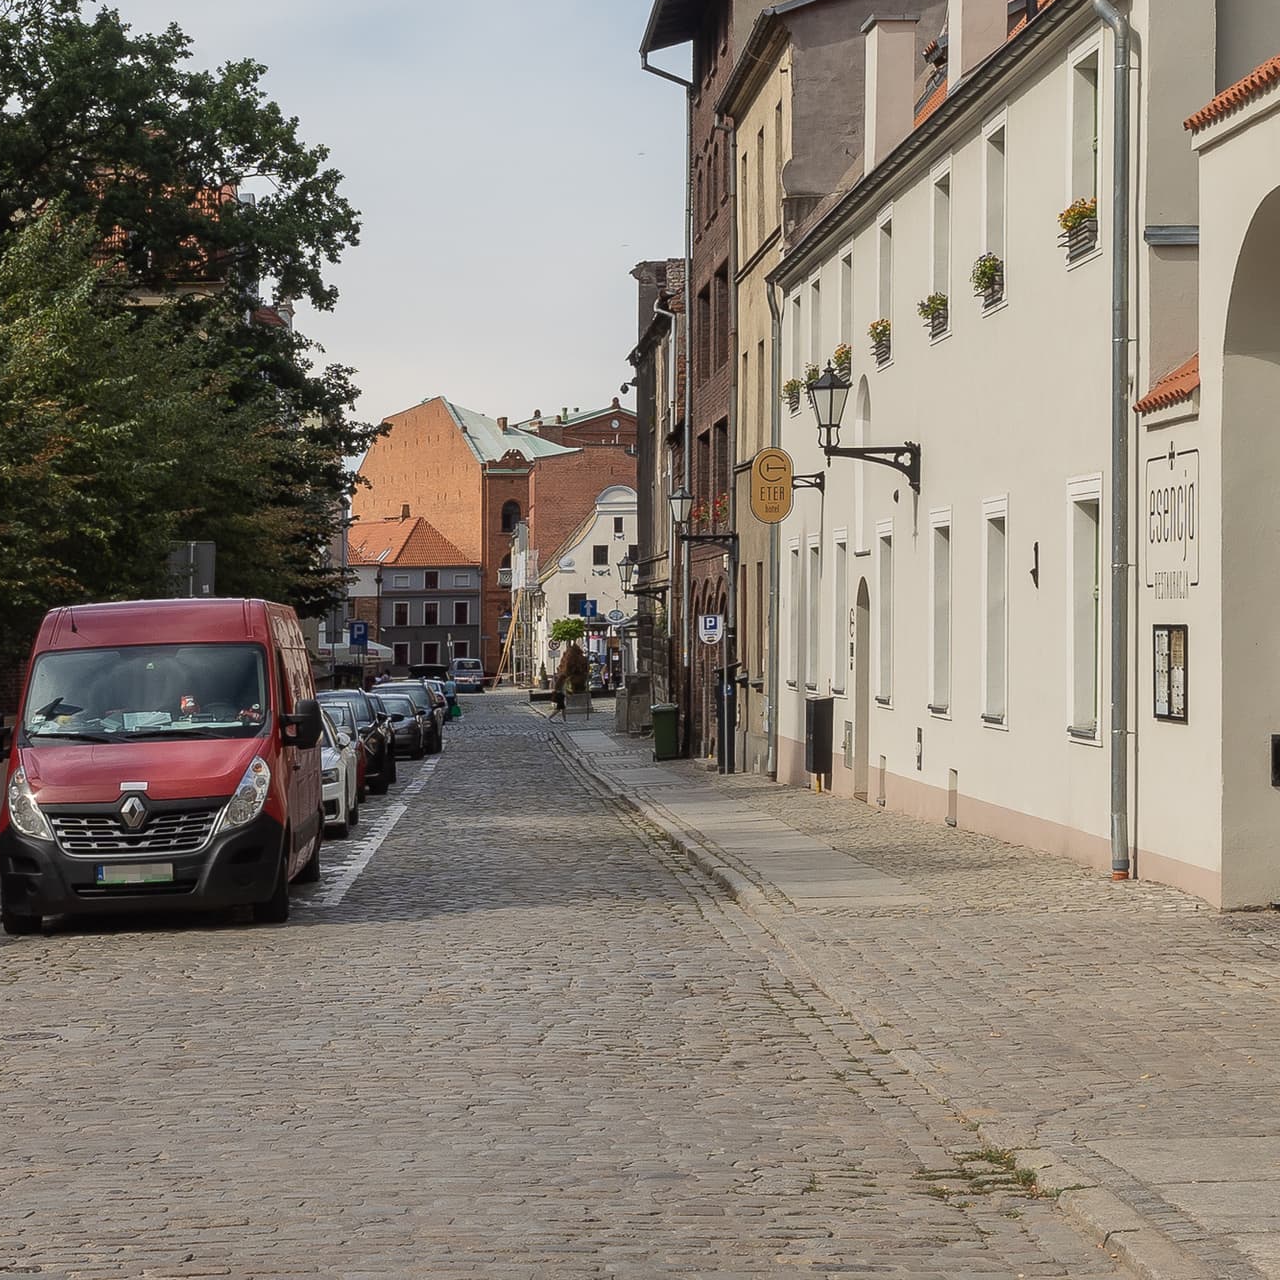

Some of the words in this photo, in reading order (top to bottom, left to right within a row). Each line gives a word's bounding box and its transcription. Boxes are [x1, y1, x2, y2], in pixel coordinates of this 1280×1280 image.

[760, 486, 785, 501] ETER
[1149, 470, 1195, 562] esencja
[706, 617, 715, 629] P
[354, 624, 365, 639] P
